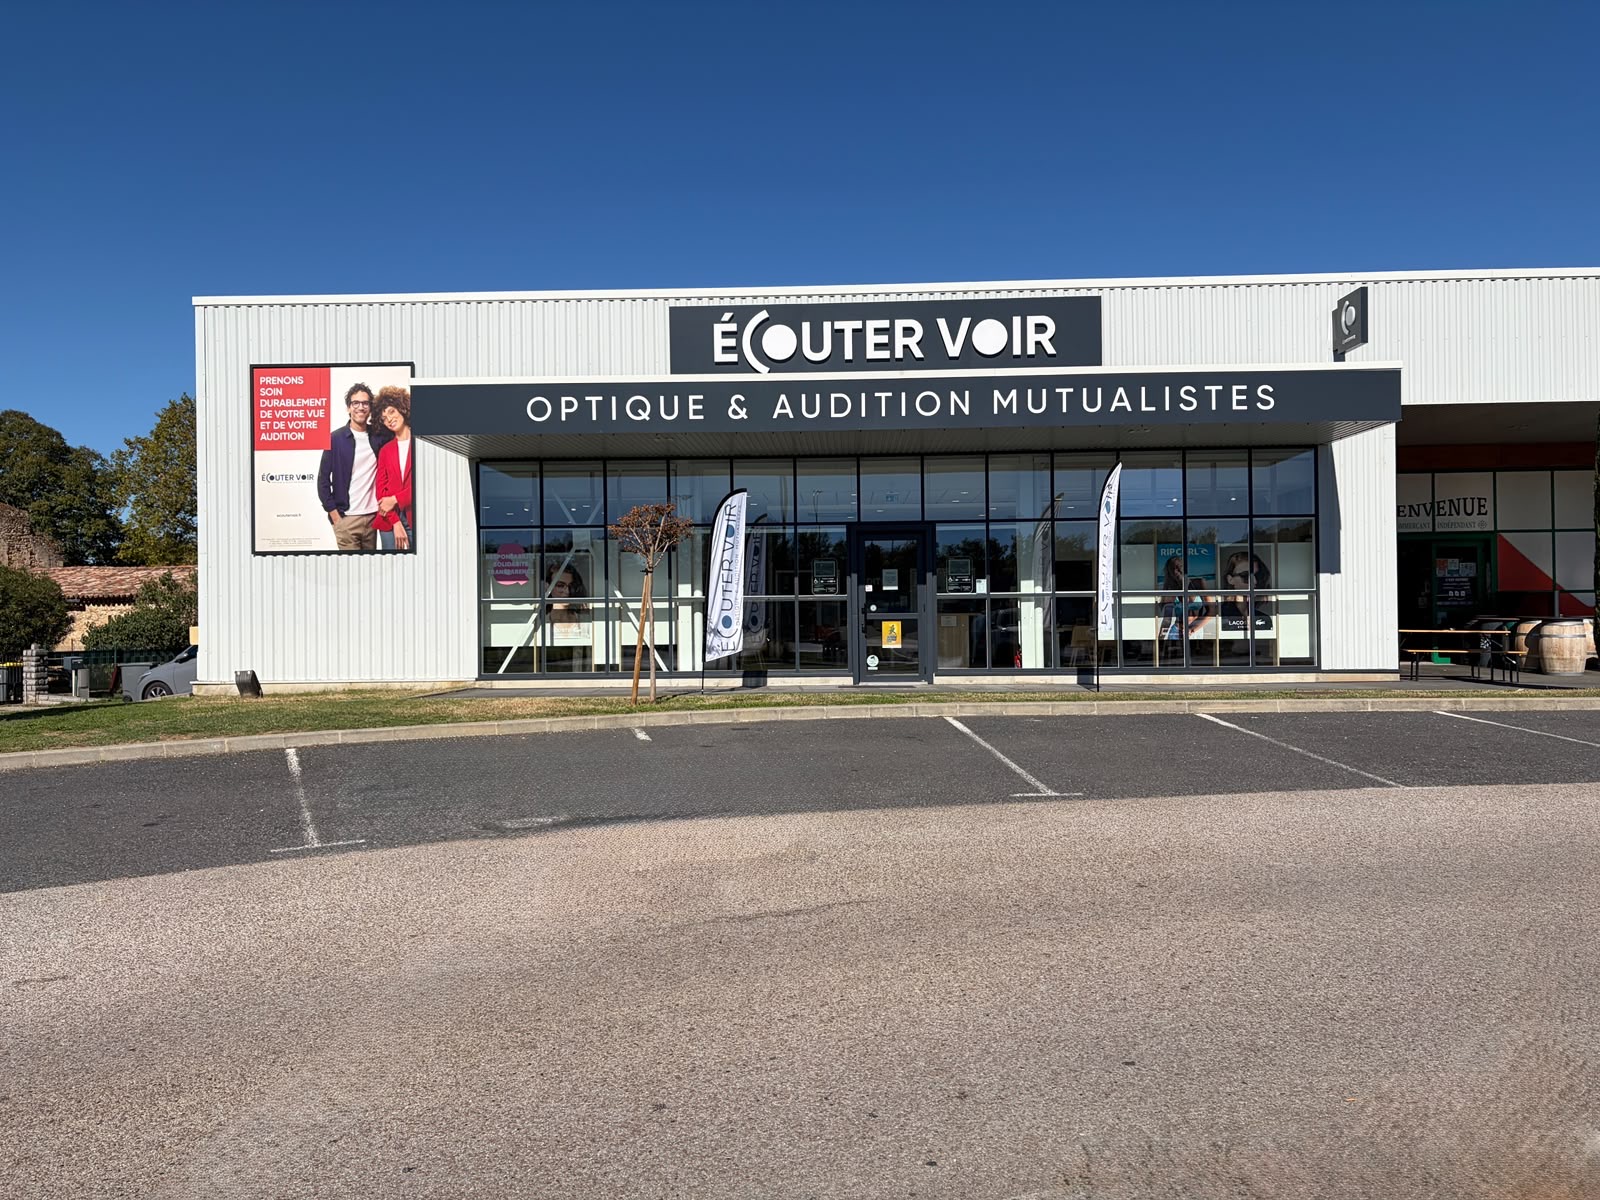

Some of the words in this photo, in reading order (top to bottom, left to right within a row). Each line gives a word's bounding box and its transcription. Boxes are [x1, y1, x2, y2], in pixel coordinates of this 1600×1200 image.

[713, 309, 924, 374] ÉCOUTER
[936, 315, 1057, 358] VOIR
[259, 376, 304, 385] PRENONS
[259, 387, 283, 396] SOIN
[259, 398, 327, 408] DURABLEMENT
[526, 394, 704, 422] OPTIQUE
[727, 394, 748, 420] &
[772, 390, 970, 420] AUDITION
[993, 384, 1275, 415] MUTUALISTES
[260, 410, 273, 419] DE
[274, 409, 305, 418] VOTRE
[306, 409, 325, 418] VUE
[260, 421, 271, 430] ET
[273, 421, 286, 430] DE
[287, 420, 318, 429] VOTRE
[260, 432, 305, 441] AUDITION
[261, 473, 295, 484] ÉCOUTER
[724, 504, 737, 552] VOIR
[1160, 548, 1175, 556] RIP
[1176, 548, 1199, 556] CRL
[717, 559, 738, 652] ÉCOUTER
